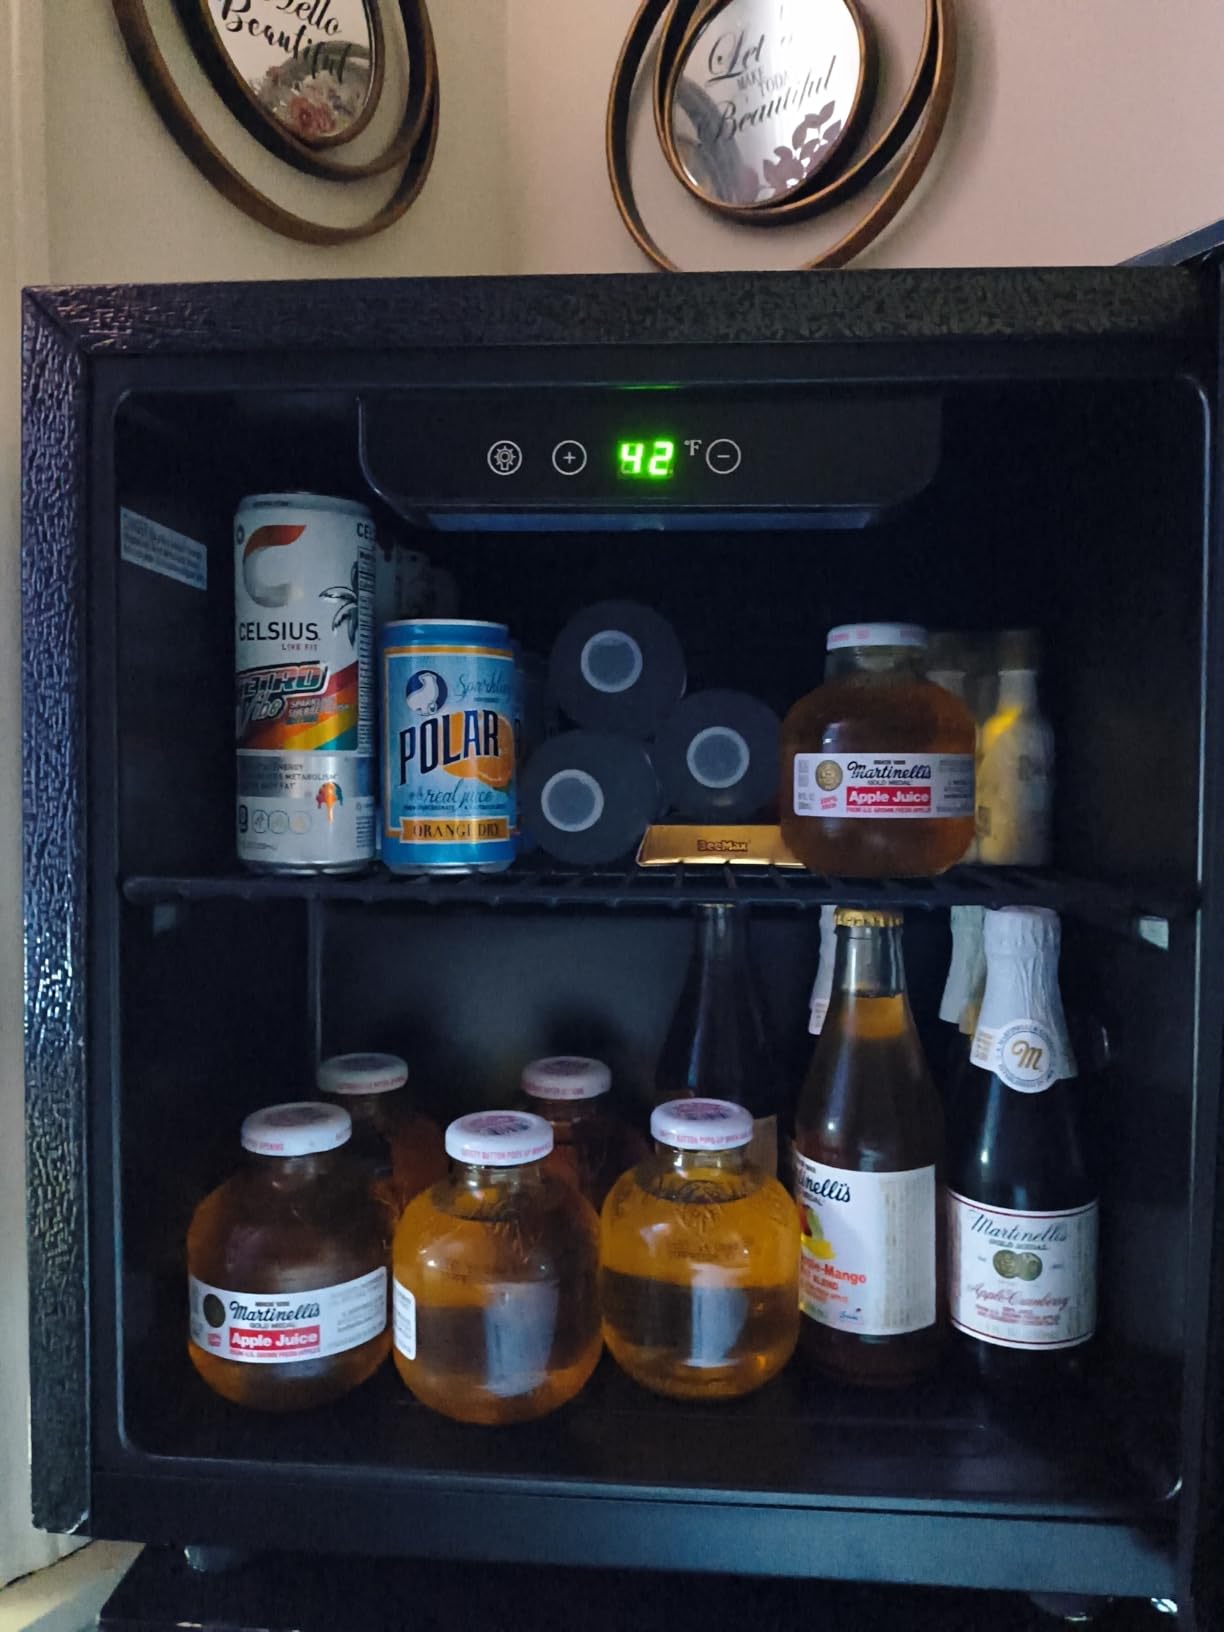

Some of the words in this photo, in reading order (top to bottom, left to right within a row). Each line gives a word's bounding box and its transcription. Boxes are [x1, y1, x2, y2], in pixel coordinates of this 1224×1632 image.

[264, 0, 342, 35] ello
[620, 440, 674, 476] 42
[239, 622, 319, 641] CELSIUS
[399, 709, 499, 786] POLAR
[849, 791, 890, 804] Apple
[892, 791, 930, 803] Juice
[697, 840, 748, 852] BeeMax
[231, 1332, 273, 1348] Apple
[274, 1333, 318, 1347] Juice
